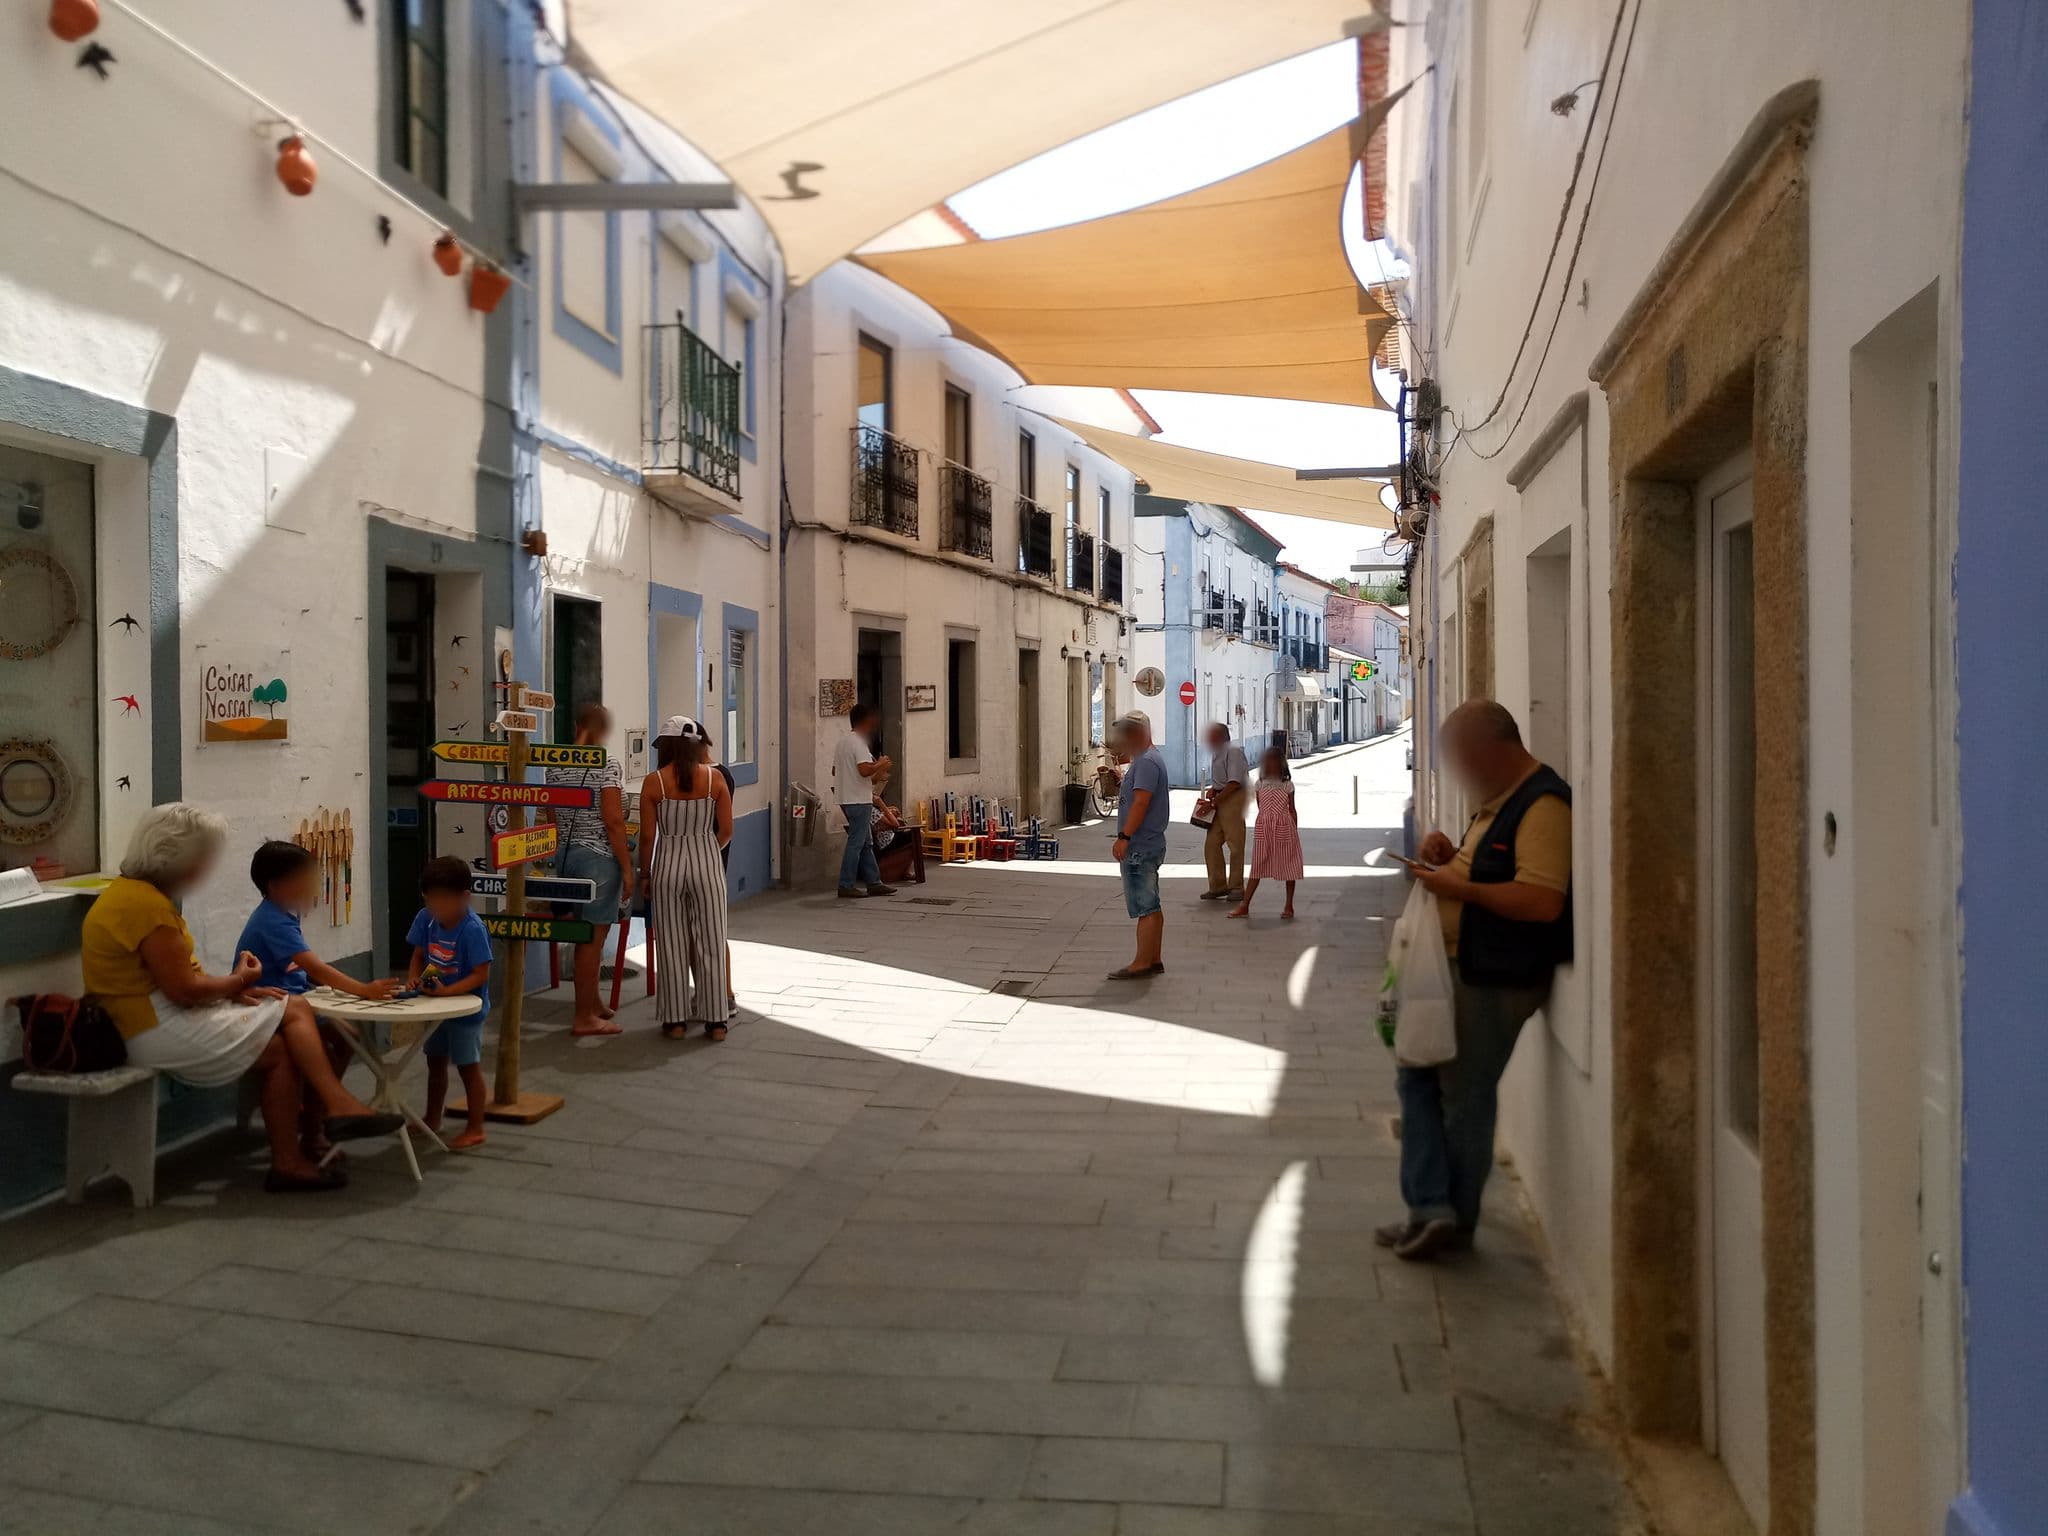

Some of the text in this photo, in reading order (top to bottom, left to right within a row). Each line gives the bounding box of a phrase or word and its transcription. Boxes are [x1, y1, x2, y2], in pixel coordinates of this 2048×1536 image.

[205, 664, 253, 692] Coisas
[205, 692, 253, 719] Nossas
[530, 748, 601, 764] LICORES
[447, 783, 550, 802] ARTESANATO
[470, 879, 506, 894] CHAS
